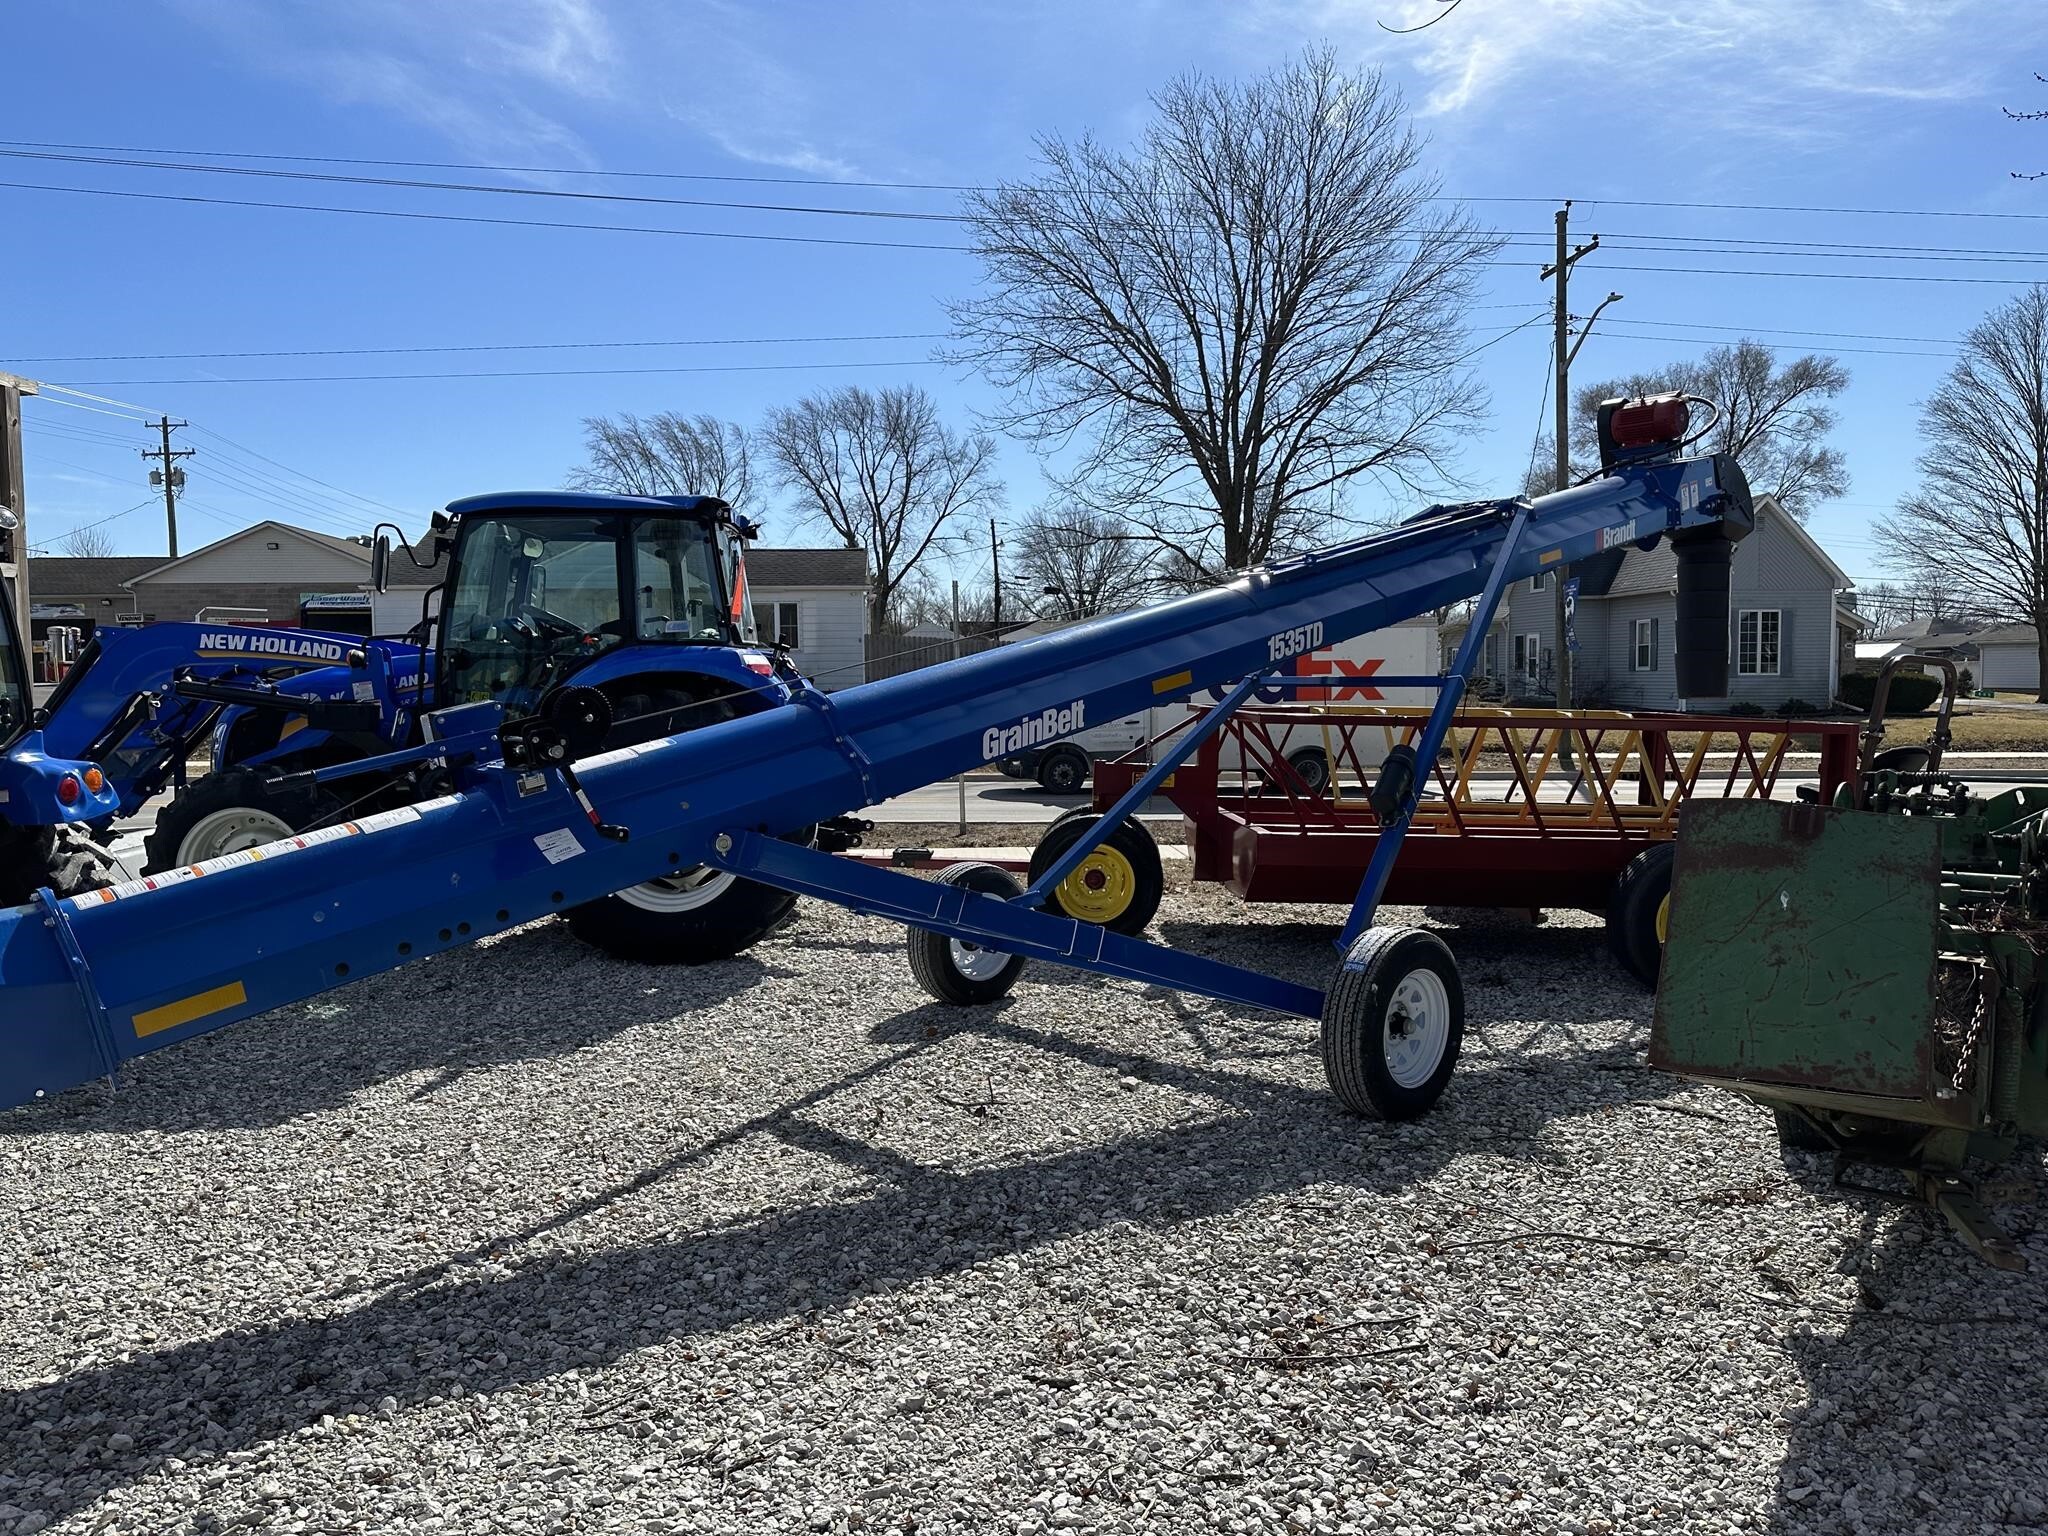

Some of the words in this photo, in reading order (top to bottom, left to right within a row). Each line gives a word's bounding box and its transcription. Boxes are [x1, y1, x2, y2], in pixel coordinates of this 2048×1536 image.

[1603, 519, 1636, 548] Brandt
[200, 633, 247, 650] NEW
[250, 636, 342, 660] HOLLAND
[1267, 620, 1324, 662] 1535TD
[982, 699, 1085, 760] GrainBelt
